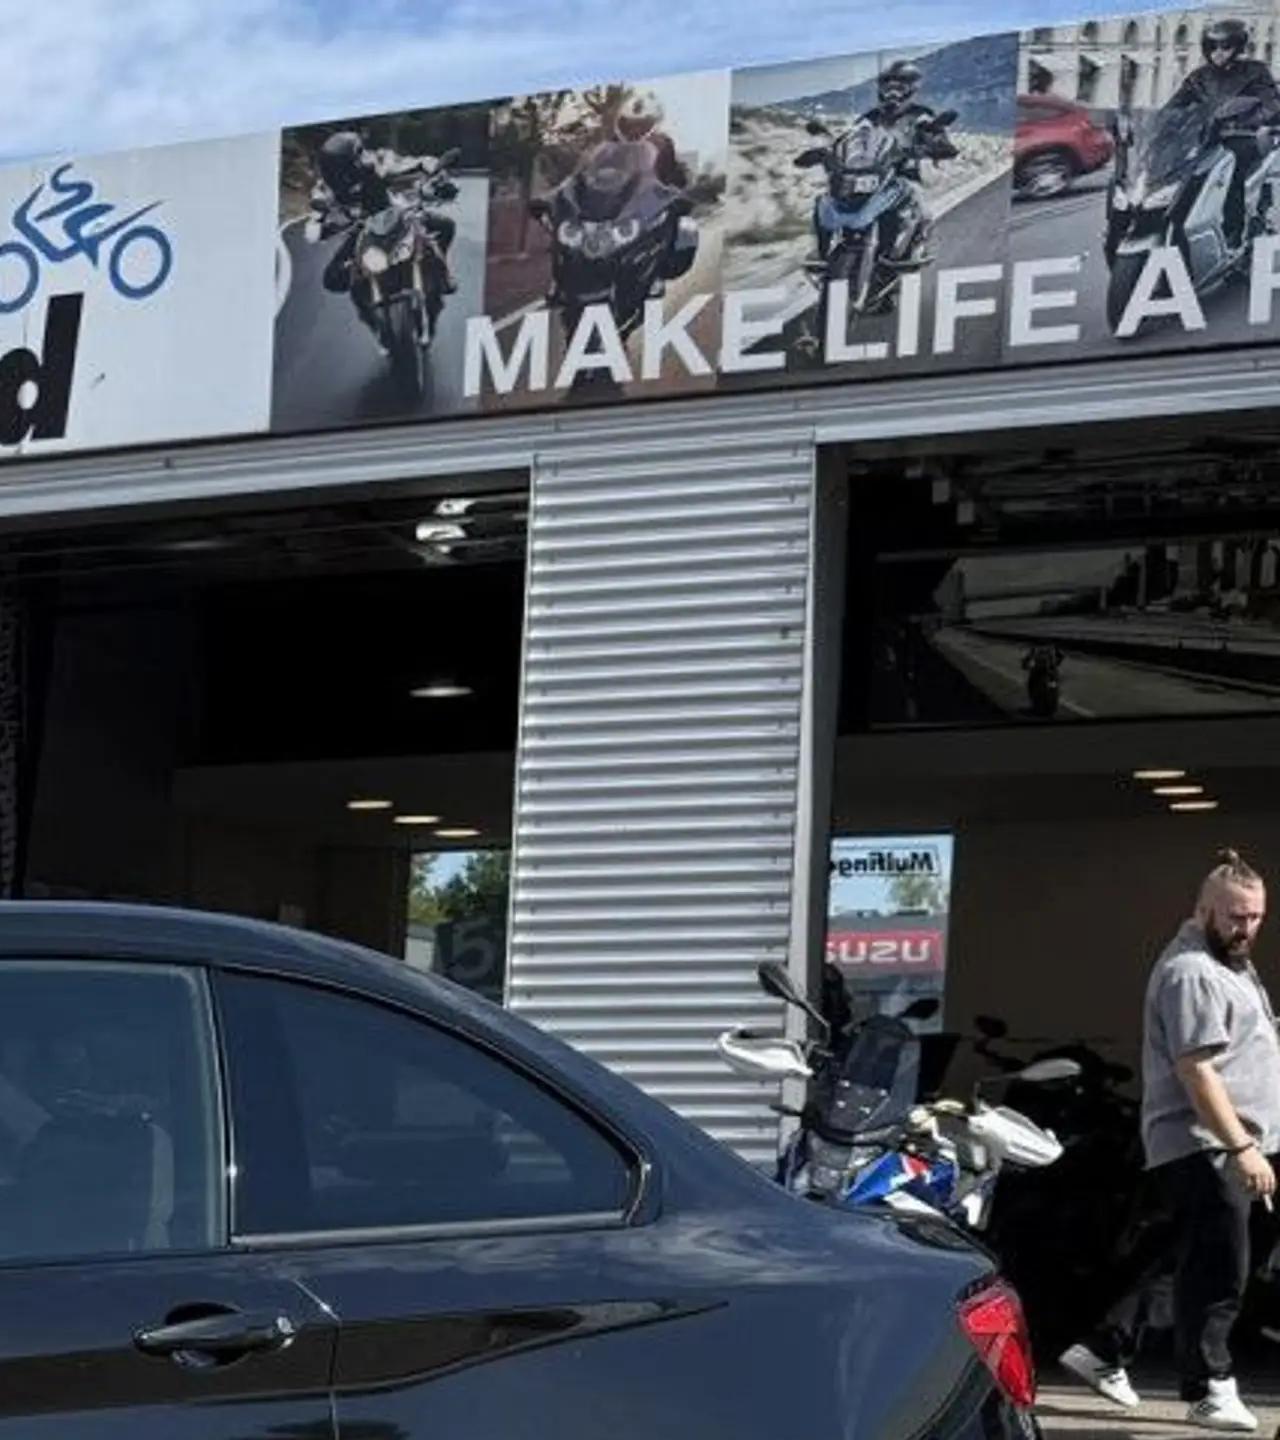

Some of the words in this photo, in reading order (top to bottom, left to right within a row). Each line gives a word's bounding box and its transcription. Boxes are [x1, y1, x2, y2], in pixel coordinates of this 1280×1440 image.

[463, 284, 788, 398] MAKE
[824, 254, 1082, 364] LIFE
[1114, 245, 1207, 338] A
